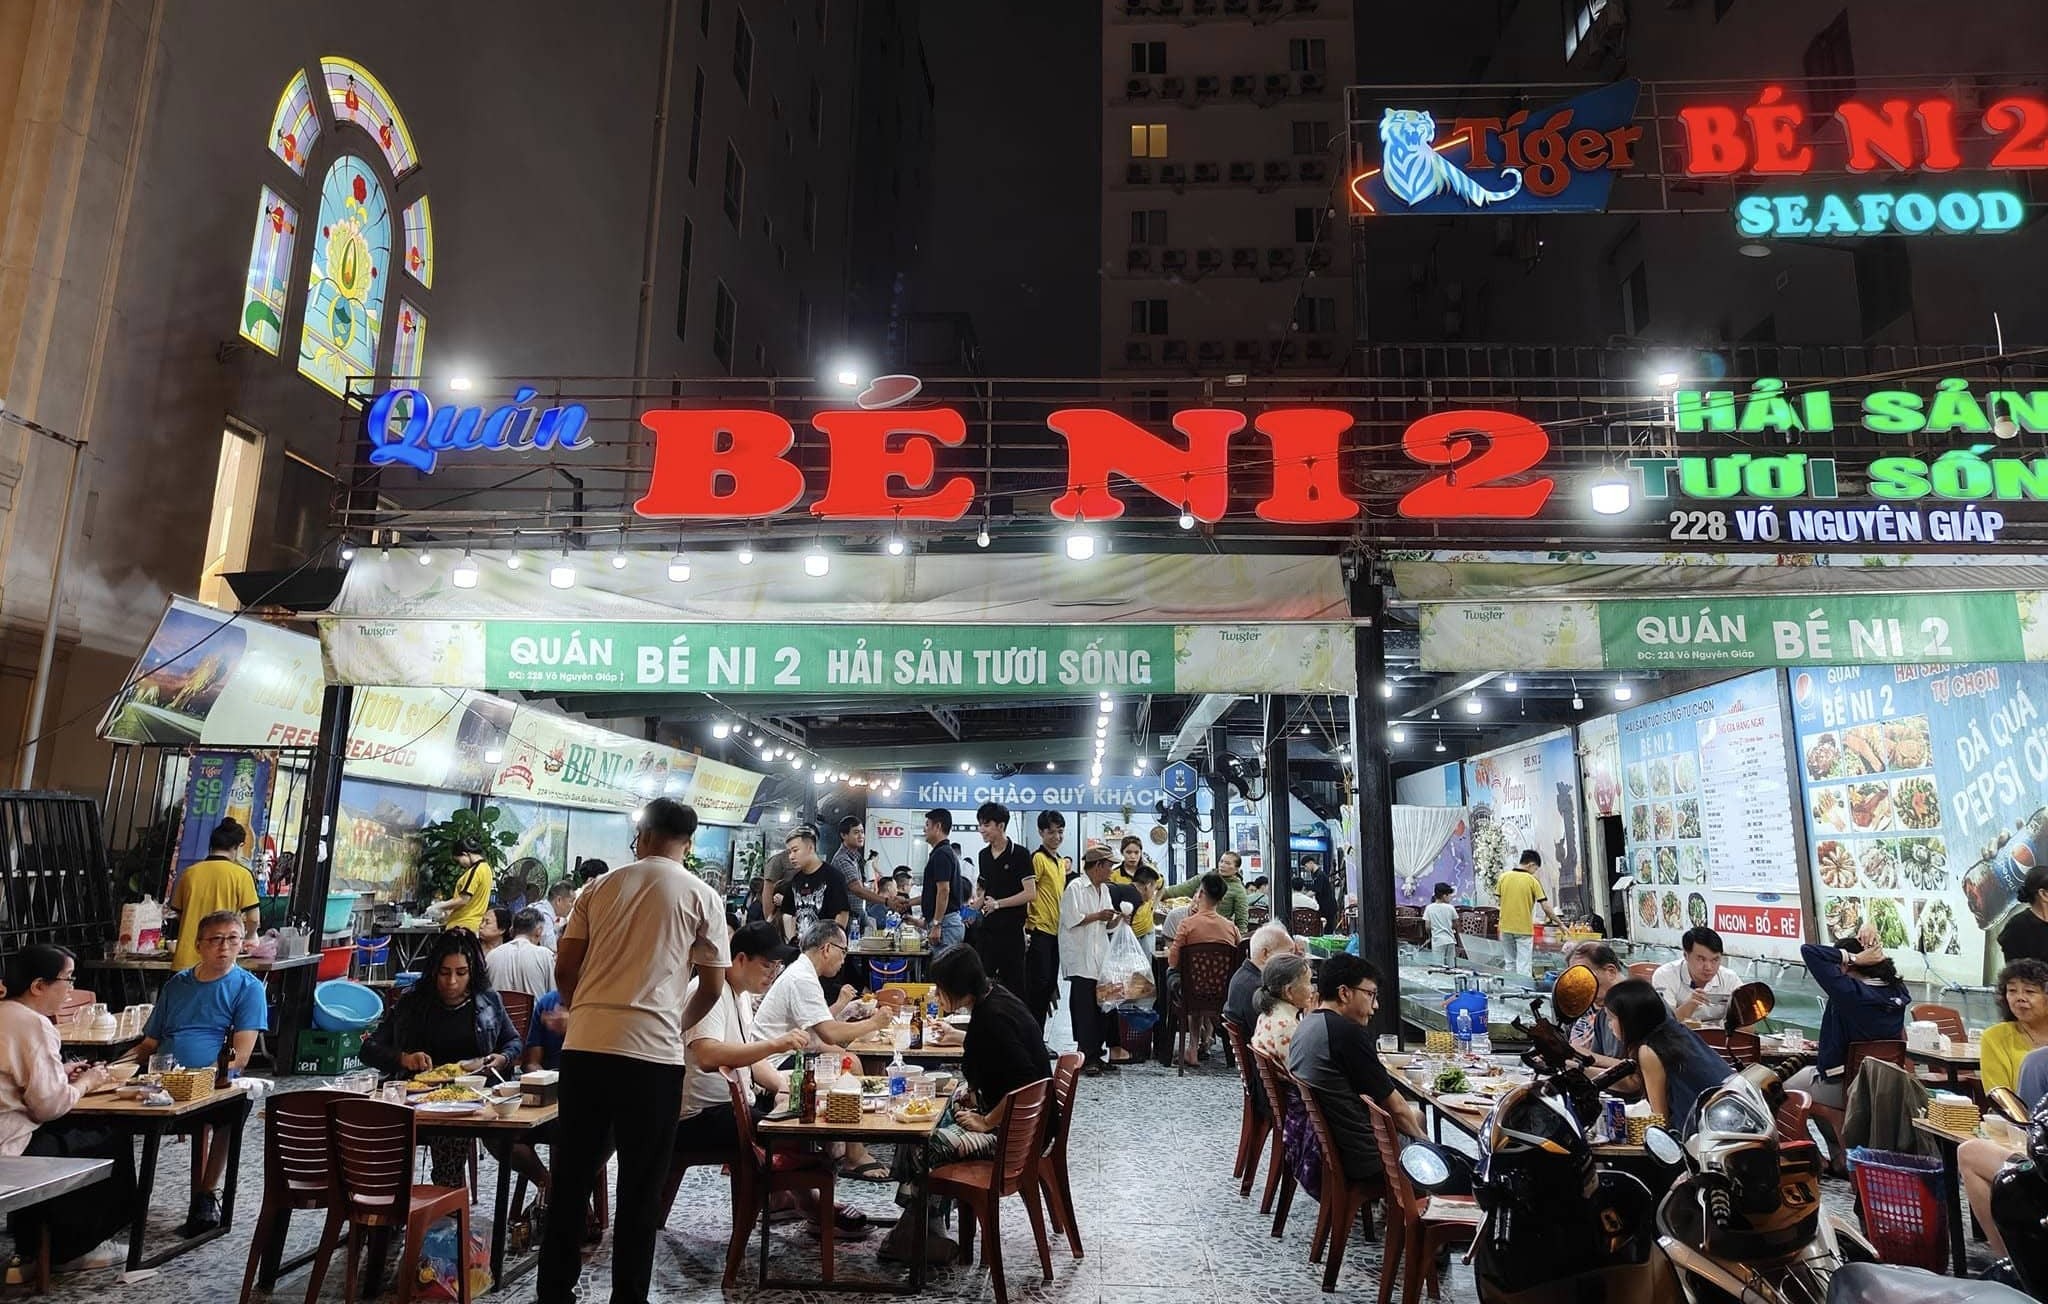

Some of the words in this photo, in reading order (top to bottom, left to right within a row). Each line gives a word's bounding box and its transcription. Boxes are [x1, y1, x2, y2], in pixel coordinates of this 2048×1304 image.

[1452, 109, 1643, 197] Tiger
[1678, 86, 1812, 175] BÉ
[1834, 99, 1961, 174] NI
[1981, 95, 2048, 170] 2
[1736, 189, 2023, 237] SEAFOOD
[1674, 378, 1834, 433] HẢI
[368, 387, 595, 474] Quán
[634, 375, 975, 521] BÉ
[1047, 409, 1360, 524] NI
[1399, 410, 1554, 518] 2
[1626, 453, 1838, 499] TƯƠI
[1669, 510, 1728, 540] 228
[1735, 505, 1779, 541] VÕ
[1789, 505, 1922, 541] NGUYÊN
[1928, 505, 2004, 541] GIÁP
[510, 629, 614, 666] QUÁN
[1218, 630, 1262, 643] Twister
[1637, 606, 1747, 644] QUÁN
[1773, 607, 1833, 659] BÉ
[1848, 618, 1904, 658] NI
[1920, 616, 1952, 656] 2
[526, 671, 543, 680] 228
[636, 634, 691, 685] BÉ
[708, 646, 757, 685] NI
[774, 646, 801, 685] 2
[828, 637, 882, 685] HẢI
[894, 637, 963, 685] SẢN
[974, 646, 1047, 685] TƯƠI
[1058, 636, 1151, 686] SỐNG
[1657, 650, 1675, 660] 228
[1730, 648, 1755, 659] Giáp
[1822, 686, 1847, 728] BÉ
[1850, 688, 1875, 723] NI
[1880, 684, 1895, 716] 2
[1990, 680, 2038, 748] QUÁ
[918, 780, 967, 803] KÍNH
[974, 780, 1036, 804] CHÀO
[1042, 782, 1086, 804] QUÝ
[1093, 780, 1168, 806] KHÁCH
[1953, 756, 2026, 836] PEPSI
[877, 826, 905, 837] WC
[1718, 912, 1747, 932] NGON
[1755, 909, 1771, 934] BỔ
